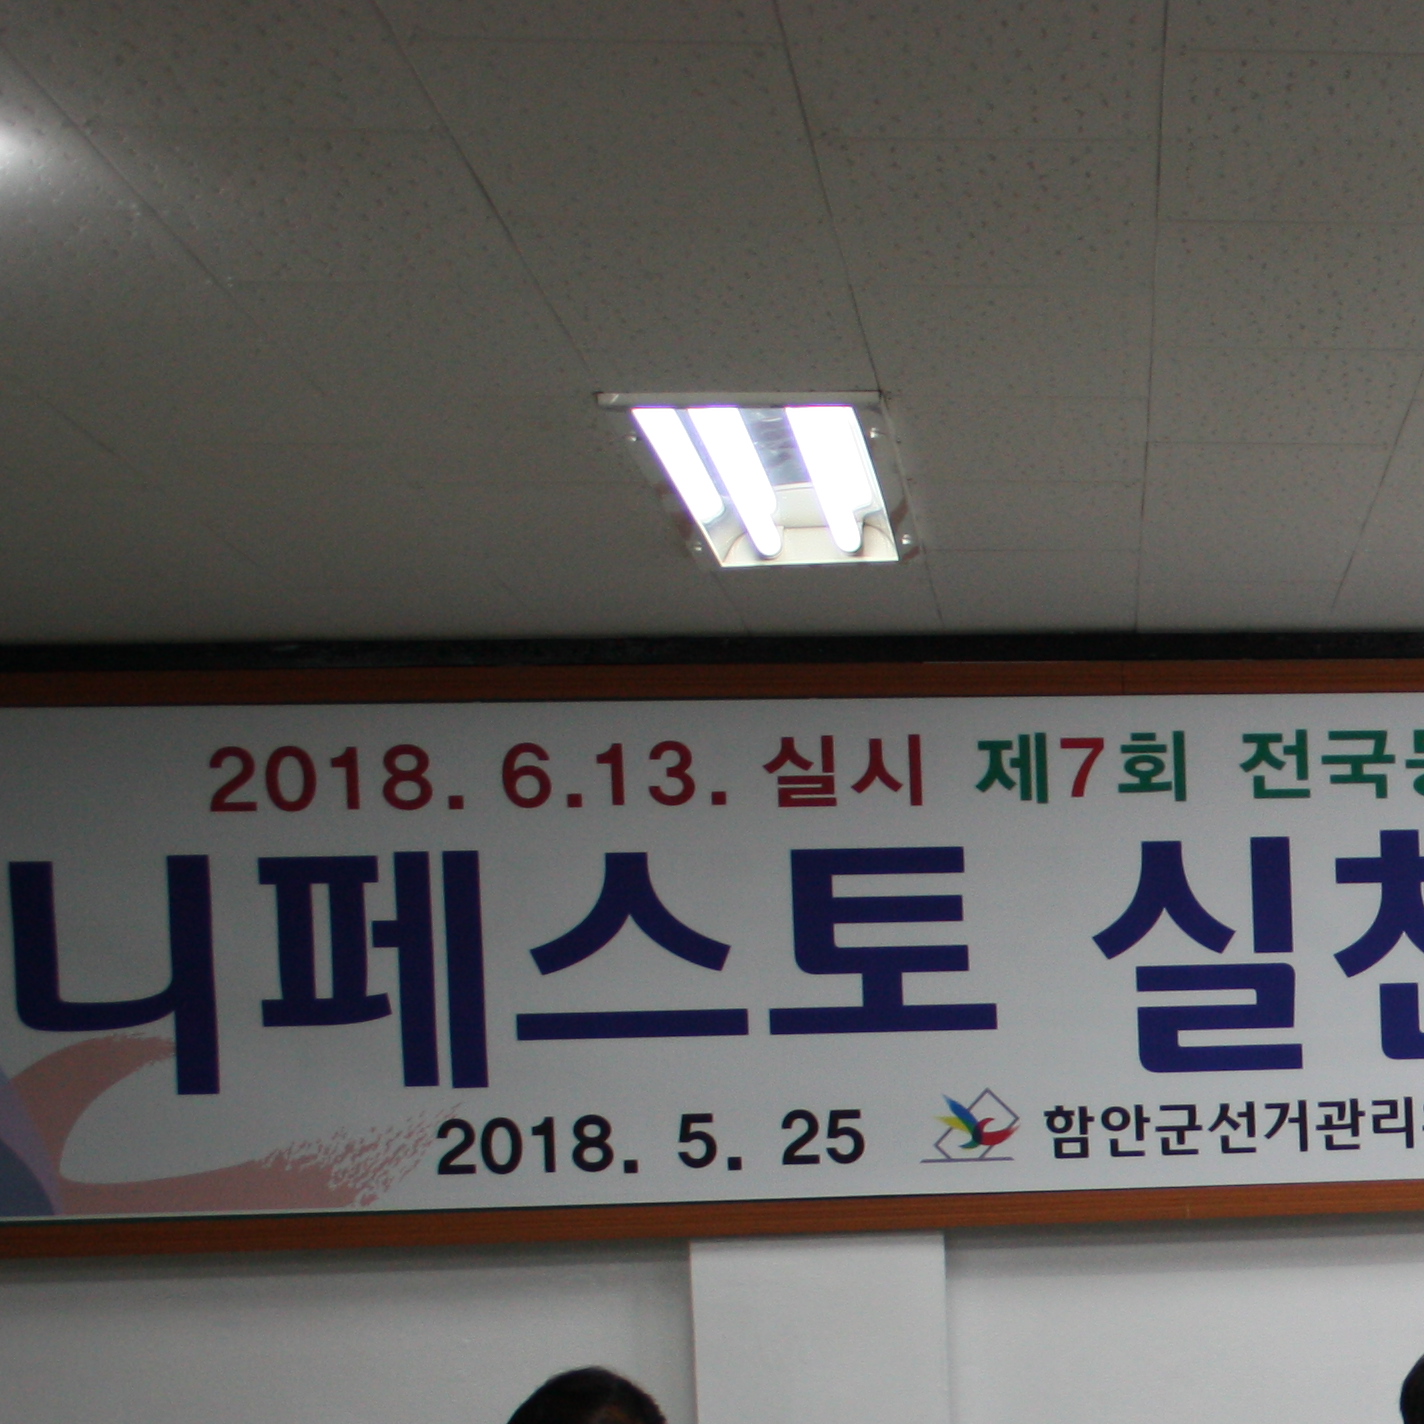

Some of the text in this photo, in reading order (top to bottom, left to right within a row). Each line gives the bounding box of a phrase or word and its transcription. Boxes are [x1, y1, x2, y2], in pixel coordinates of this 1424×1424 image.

[209, 745, 464, 811] 2018.
[501, 741, 727, 808] 6.13.
[763, 735, 923, 807] 실시
[975, 731, 1187, 803] 제7회
[7, 846, 998, 1095] 니페스토
[436, 1108, 865, 1175] 2018. 5. 25
